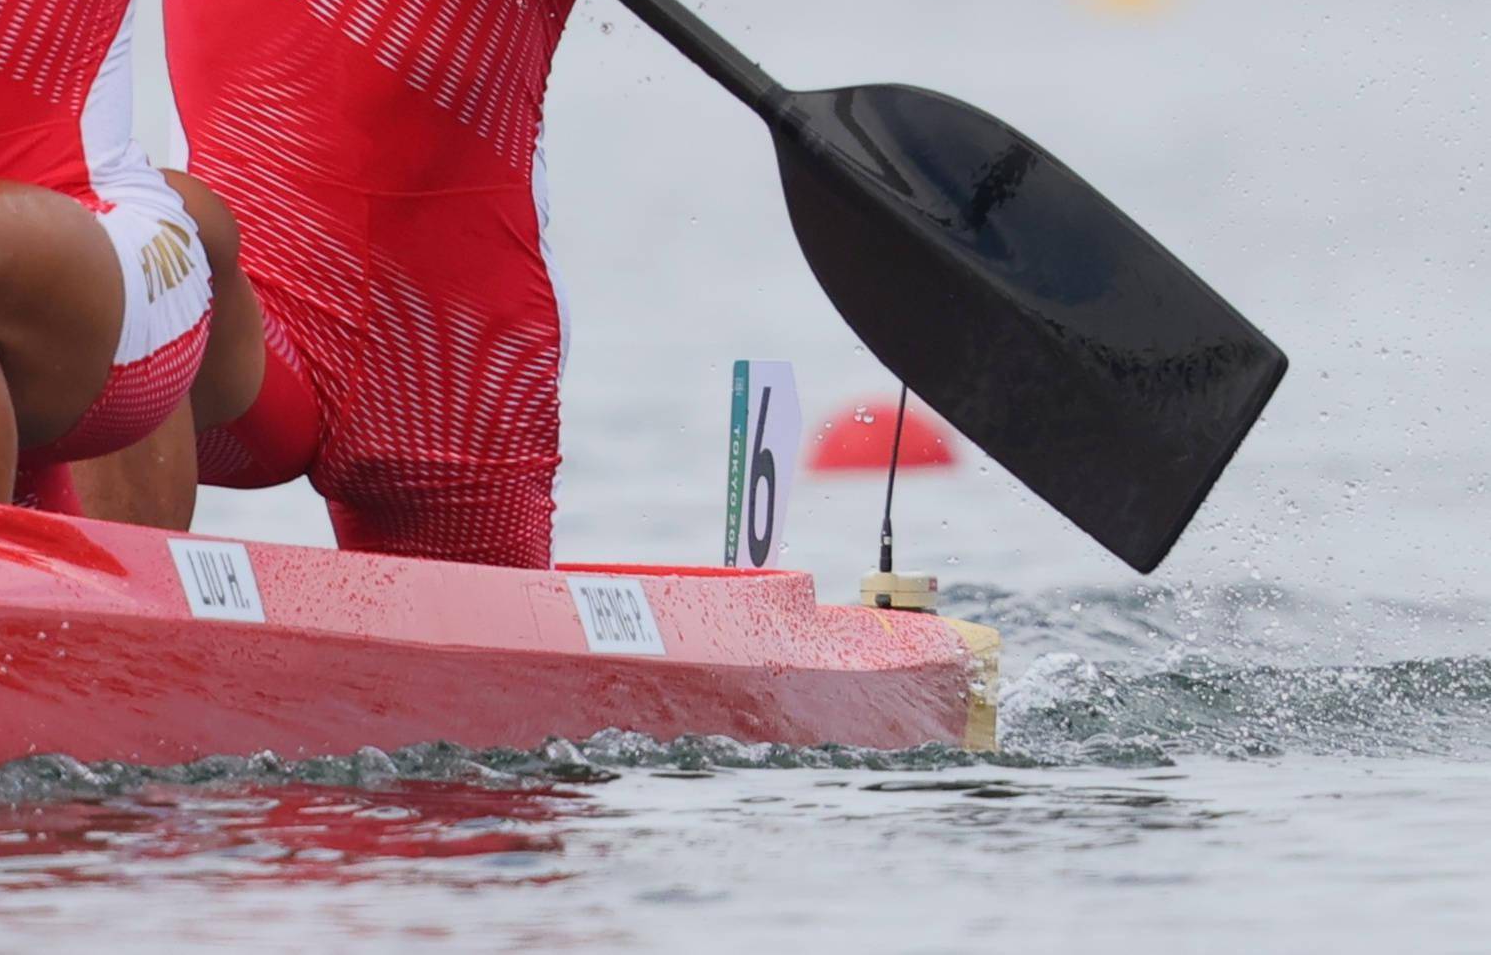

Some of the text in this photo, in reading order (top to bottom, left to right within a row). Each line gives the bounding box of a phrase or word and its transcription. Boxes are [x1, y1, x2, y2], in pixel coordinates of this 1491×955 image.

[730, 423, 742, 507] TOKYO
[747, 386, 776, 568] 6
[186, 549, 226, 607] LIU
